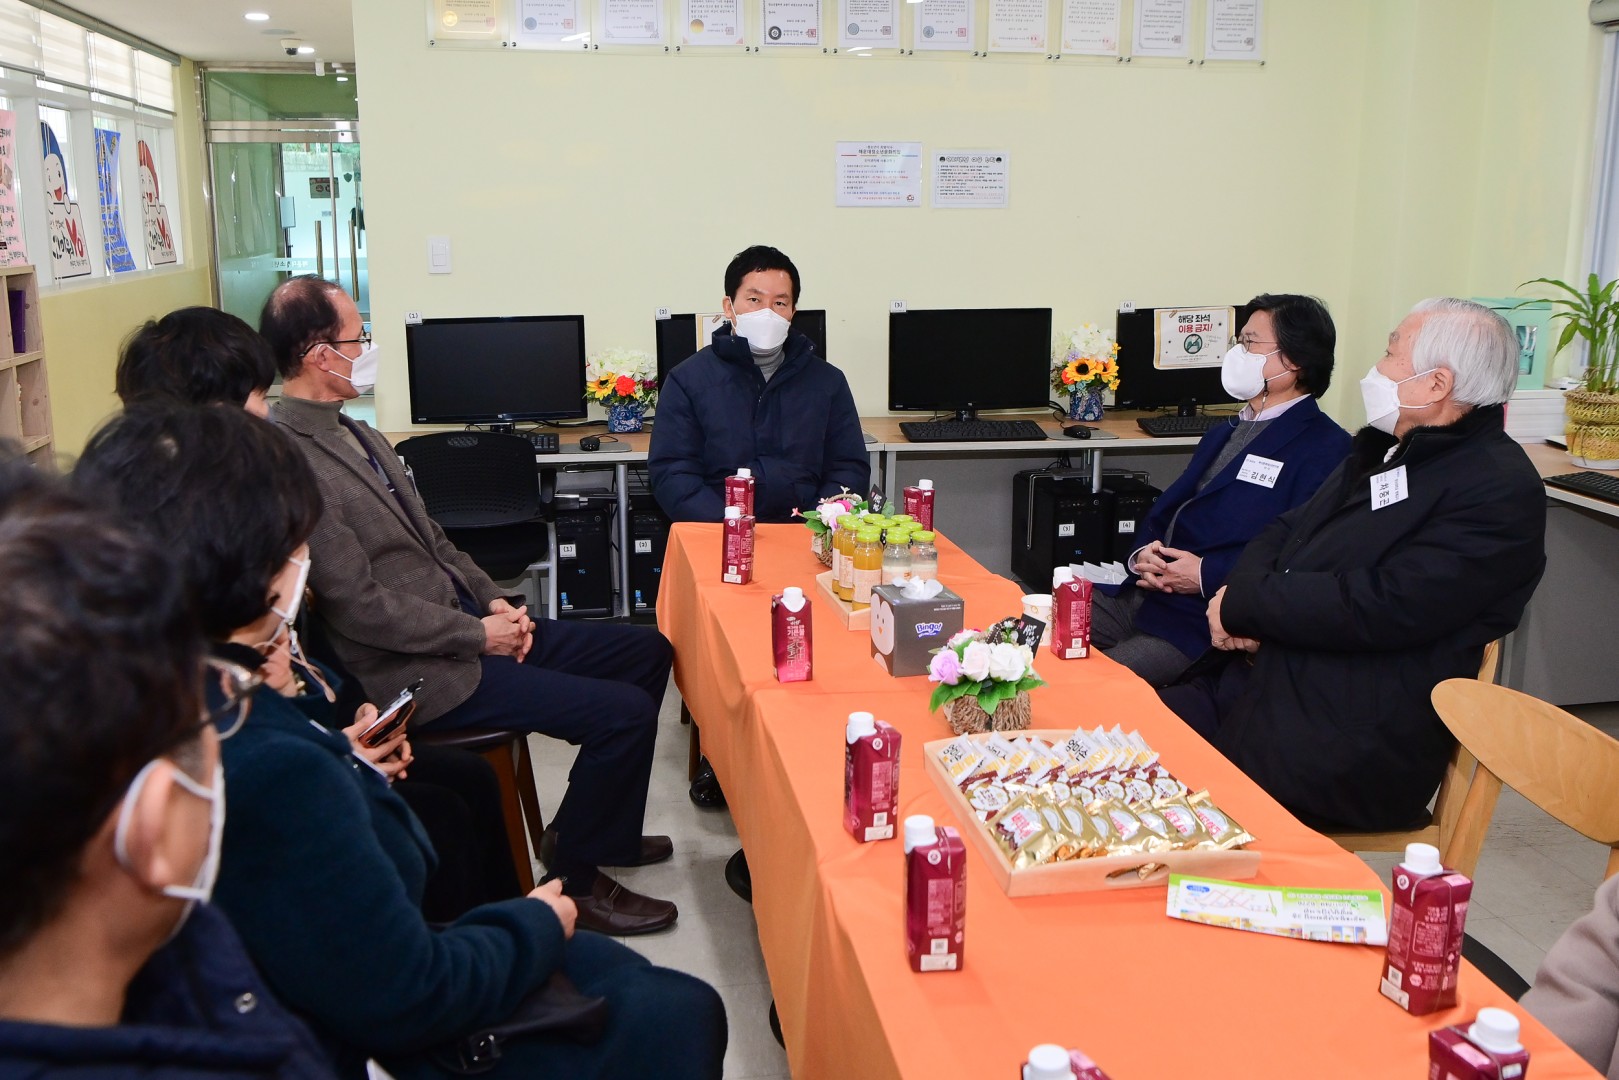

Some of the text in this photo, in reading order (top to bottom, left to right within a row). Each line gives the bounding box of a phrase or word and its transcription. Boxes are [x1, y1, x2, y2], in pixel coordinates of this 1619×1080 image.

[1178, 313, 1211, 324] 해당 좌석
[1178, 323, 1214, 334] 이용 금지!
[915, 622, 943, 634] Bingo!
